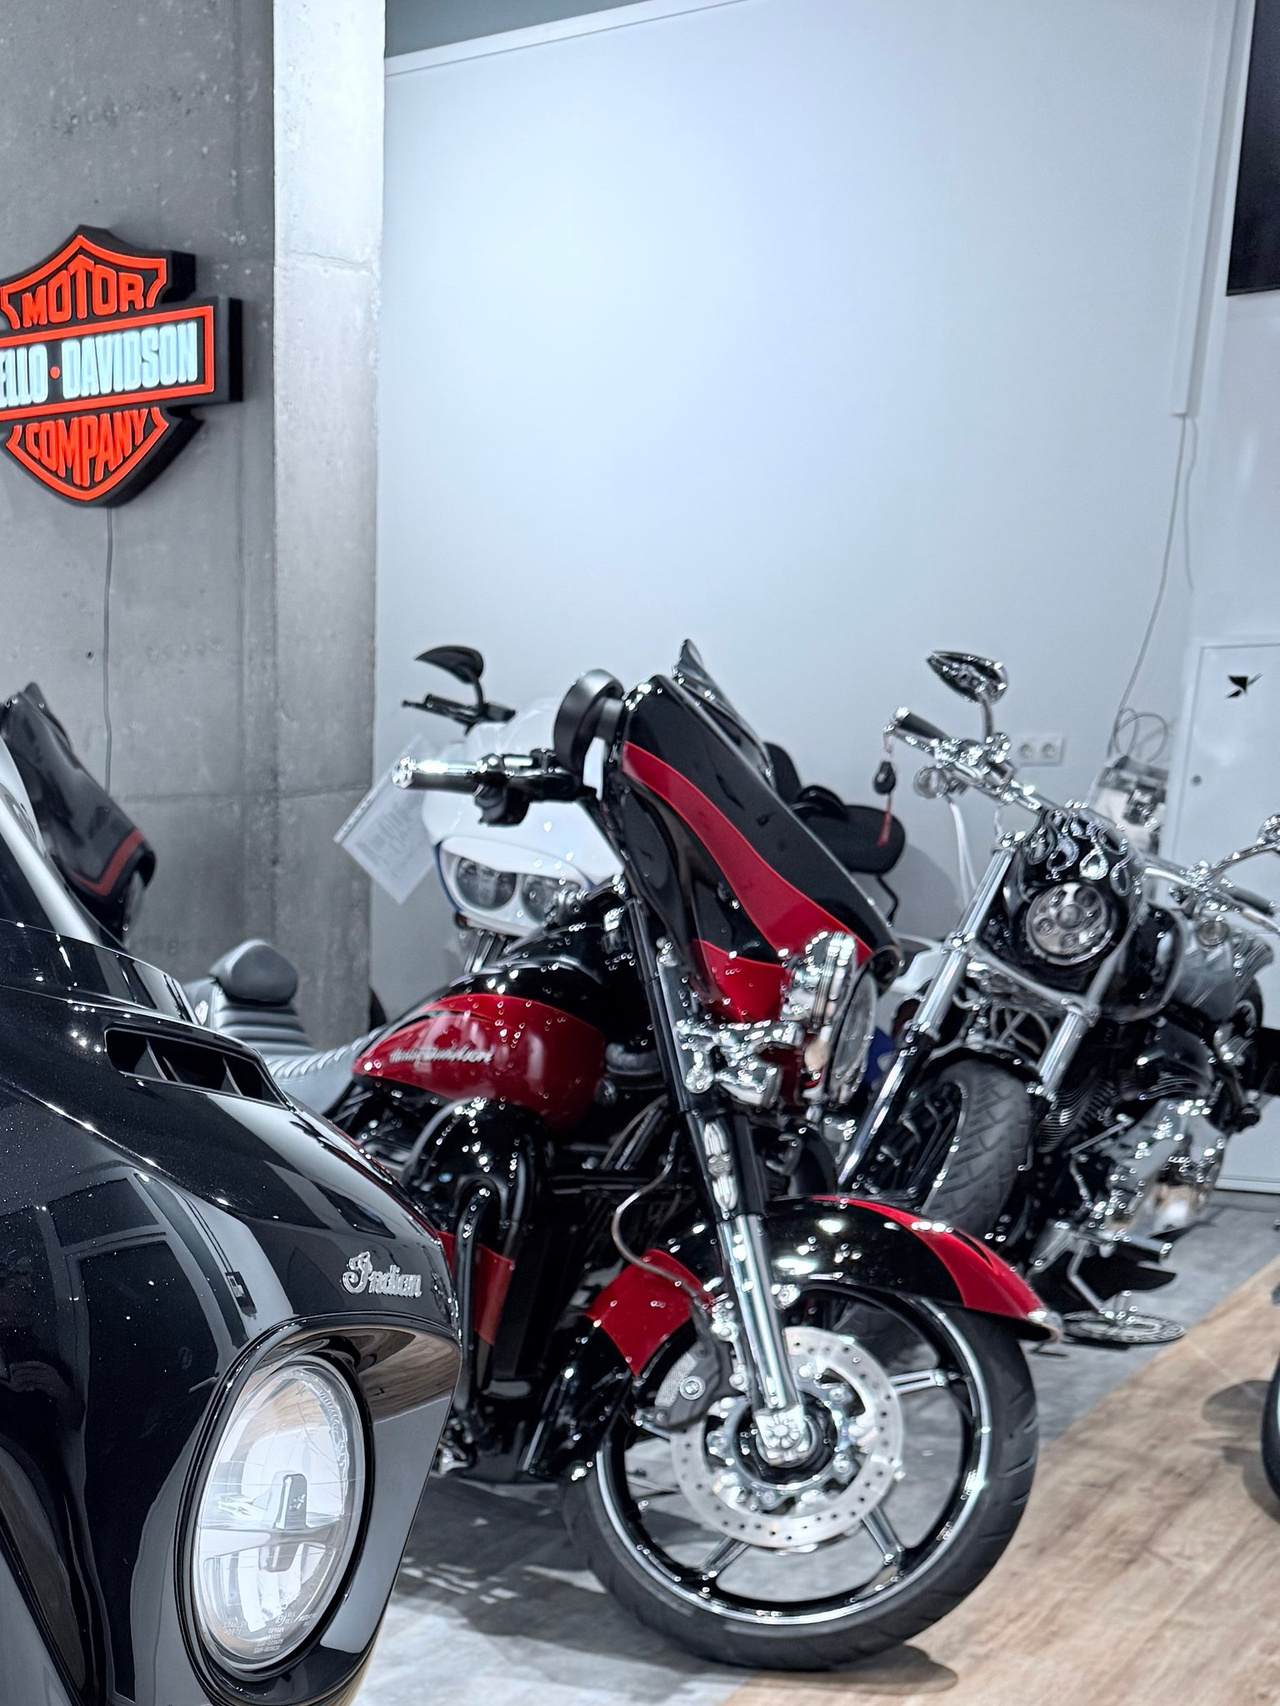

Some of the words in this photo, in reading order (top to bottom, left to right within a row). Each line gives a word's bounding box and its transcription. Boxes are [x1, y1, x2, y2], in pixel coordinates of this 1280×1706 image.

[21, 254, 145, 328] MOTOR
[60, 320, 199, 400] DAVIDSON
[24, 407, 149, 488] COMPANY
[342, 1251, 422, 1298] Indian
